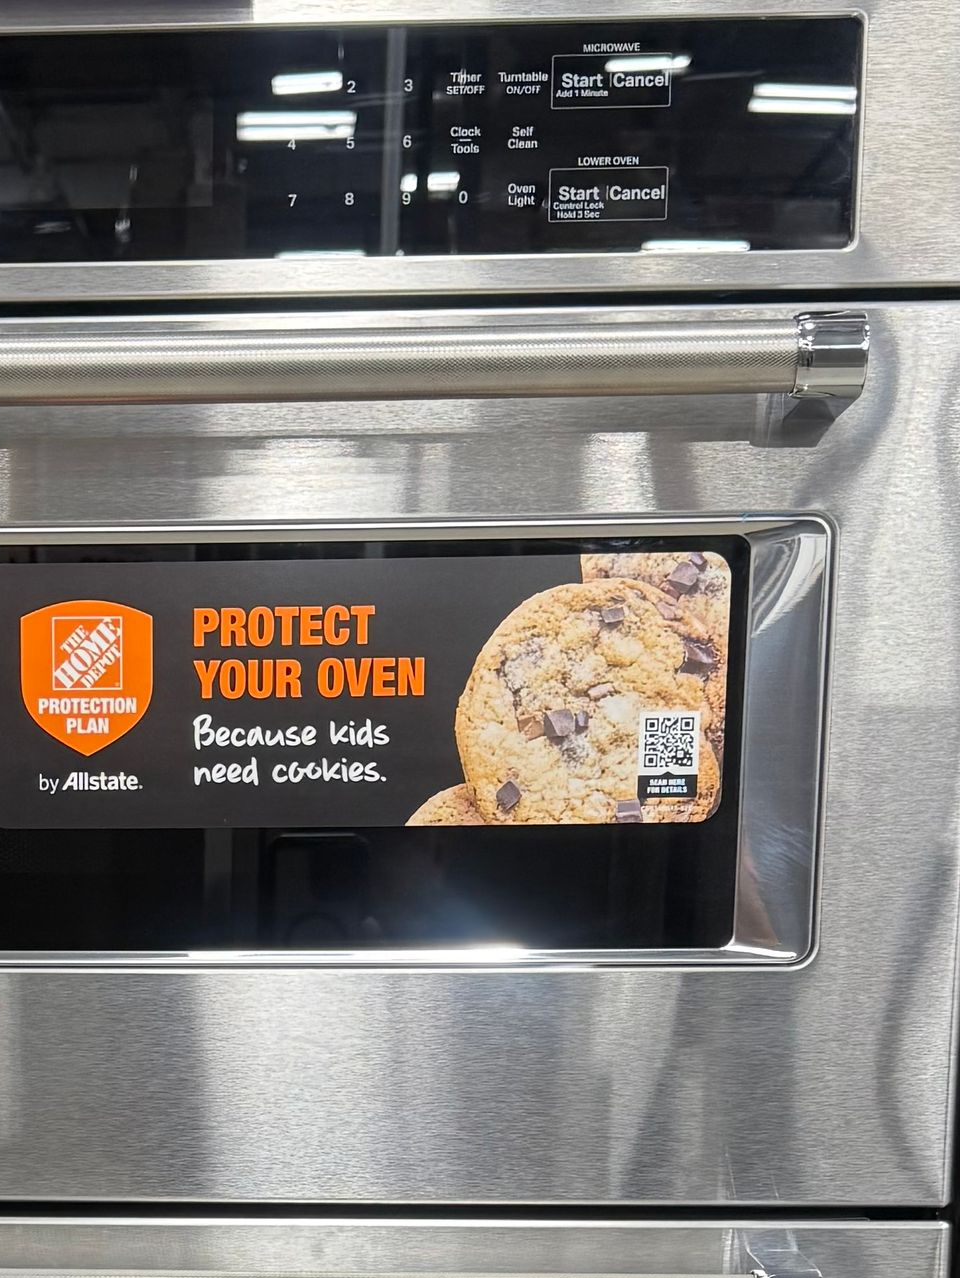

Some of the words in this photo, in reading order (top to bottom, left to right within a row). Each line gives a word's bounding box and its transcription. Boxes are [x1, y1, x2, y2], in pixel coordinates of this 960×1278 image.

[583, 43, 640, 53] MICROWAVE
[450, 71, 482, 82] Timer
[498, 71, 549, 82] Turntable
[562, 73, 603, 88] Start
[613, 70, 669, 87] Cancel
[347, 81, 356, 93] 2
[404, 79, 413, 92] 3
[446, 85, 485, 95] SET/OFF
[506, 85, 541, 94] ON/OFF
[556, 89, 572, 98] Add
[574, 89, 579, 97] 1
[581, 89, 608, 97] Minute
[450, 126, 481, 137] Clock
[512, 126, 534, 137] Self
[287, 139, 296, 150] 4
[346, 137, 355, 149] 5
[403, 135, 412, 148] 6
[507, 139, 538, 149] Clean
[451, 143, 480, 154] Tools
[578, 157, 611, 166] LOWER
[613, 156, 639, 165] OVEN
[508, 183, 536, 193] Oven
[559, 185, 600, 201] Start
[610, 184, 665, 200] Cancel
[288, 194, 297, 207] 7
[345, 193, 354, 205] 8
[402, 193, 411, 205] 9
[458, 190, 468, 204] 0
[508, 195, 535, 208] Light
[553, 202, 583, 210] Control
[584, 201, 604, 209] Lock
[557, 211, 575, 219] Hold
[193, 605, 376, 647] PROTECT
[59, 625, 89, 654] THE
[54, 617, 121, 689] HOME
[80, 644, 121, 689] DEPOT
[193, 658, 303, 700] YOUR
[317, 657, 425, 698] OVEN
[38, 697, 138, 715] PROTECTION
[66, 717, 110, 735] PLAN
[192, 713, 317, 750] Because
[329, 718, 390, 748] kids
[193, 756, 259, 786] need
[271, 757, 387, 784] cookies.
[39, 773, 60, 795] by
